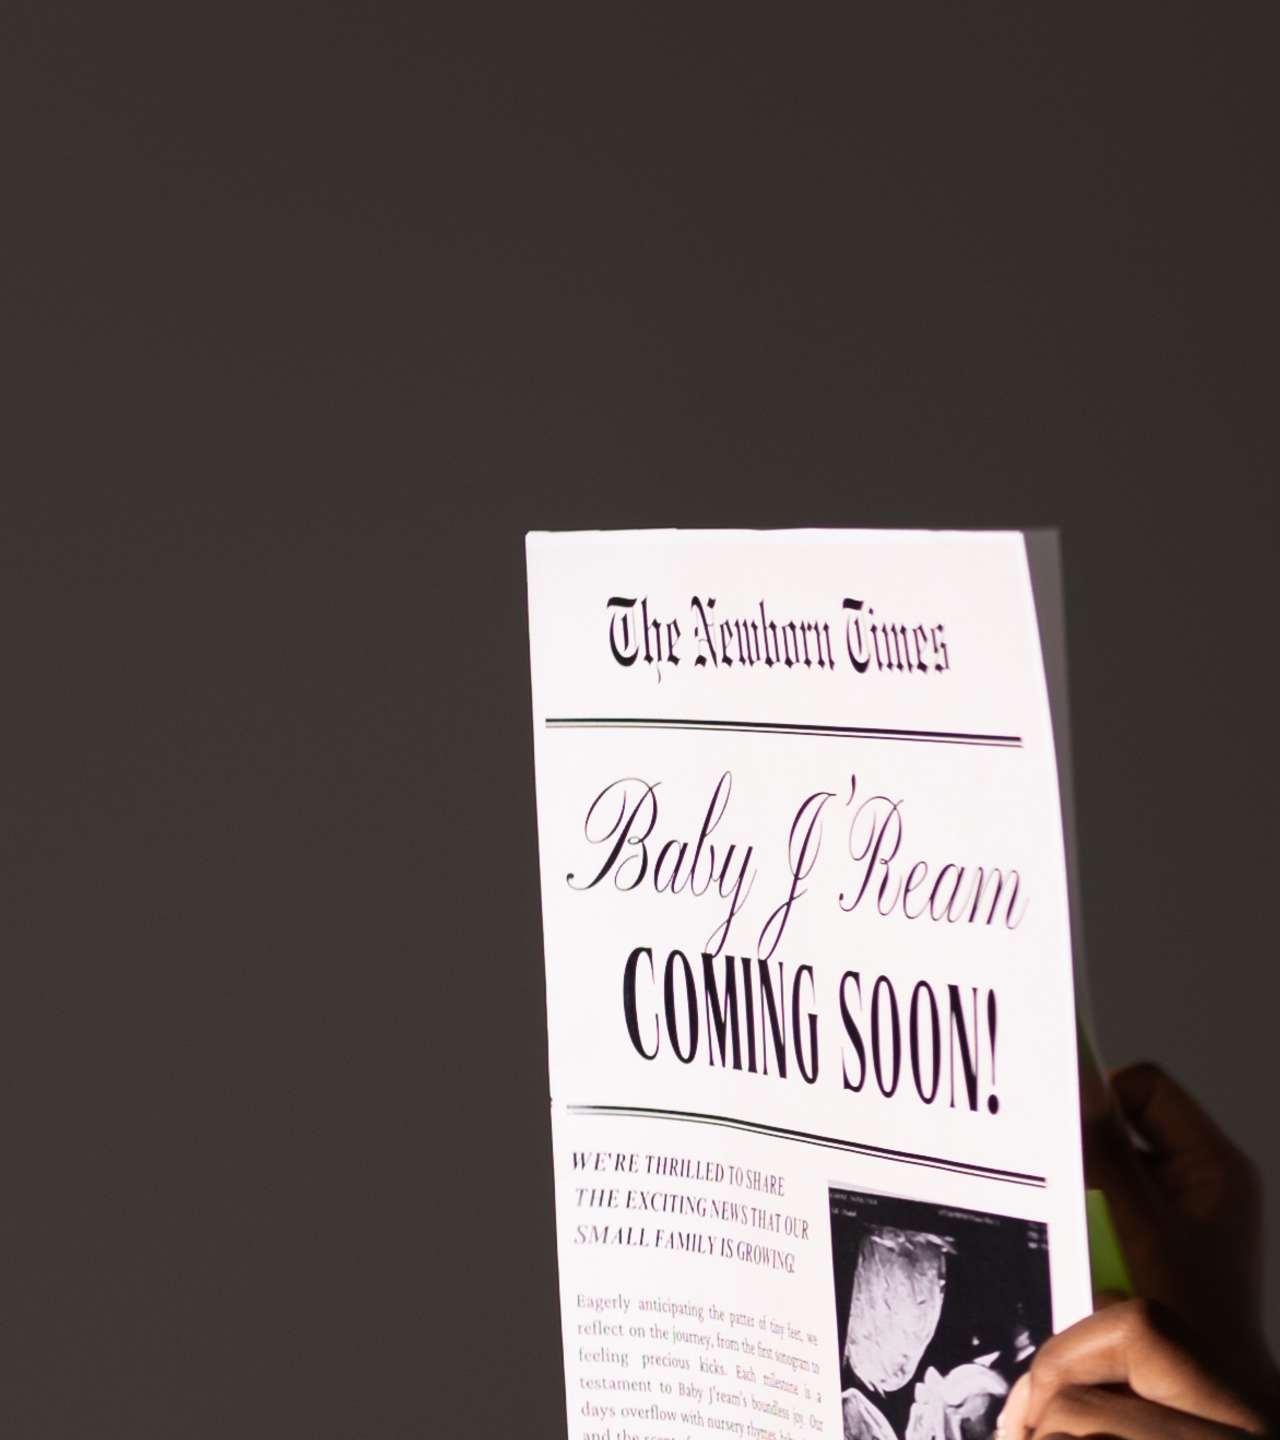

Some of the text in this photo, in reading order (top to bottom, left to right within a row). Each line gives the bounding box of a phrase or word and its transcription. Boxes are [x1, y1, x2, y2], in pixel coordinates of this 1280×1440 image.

[606, 595, 950, 684] The Newborn Times
[566, 770, 1029, 961] Baby J'Ream
[622, 946, 1000, 1115] COMING SOON!
[571, 1151, 785, 1198] WE'RE THRILLED TO SHARE
[575, 1187, 810, 1241] THE EXCITING NEWS THAT OUR
[574, 1224, 650, 1248] SMALL
[655, 1228, 717, 1256] FAMILY
[720, 1237, 734, 1260] IS
[577, 1293, 630, 1313] Eagerly
[639, 1296, 704, 1322] anticipating
[709, 1304, 725, 1322] the
[578, 1319, 625, 1337] reflect
[629, 1325, 646, 1338] on
[650, 1323, 669, 1340] the
[673, 1325, 714, 1351] journey,
[717, 1332, 739, 1352] from
[742, 1337, 755, 1356] the
[578, 1346, 629, 1368] feeling
[642, 1351, 690, 1369] precious
[699, 1355, 728, 1376] kicks.
[580, 1378, 652, 1392] testament
[660, 1381, 672, 1394] to
[678, 1381, 703, 1405] Baby
[581, 1400, 616, 1422] days
[621, 1404, 677, 1421] overflow
[681, 1410, 704, 1428] with
[707, 1417, 744, 1438] nursery
